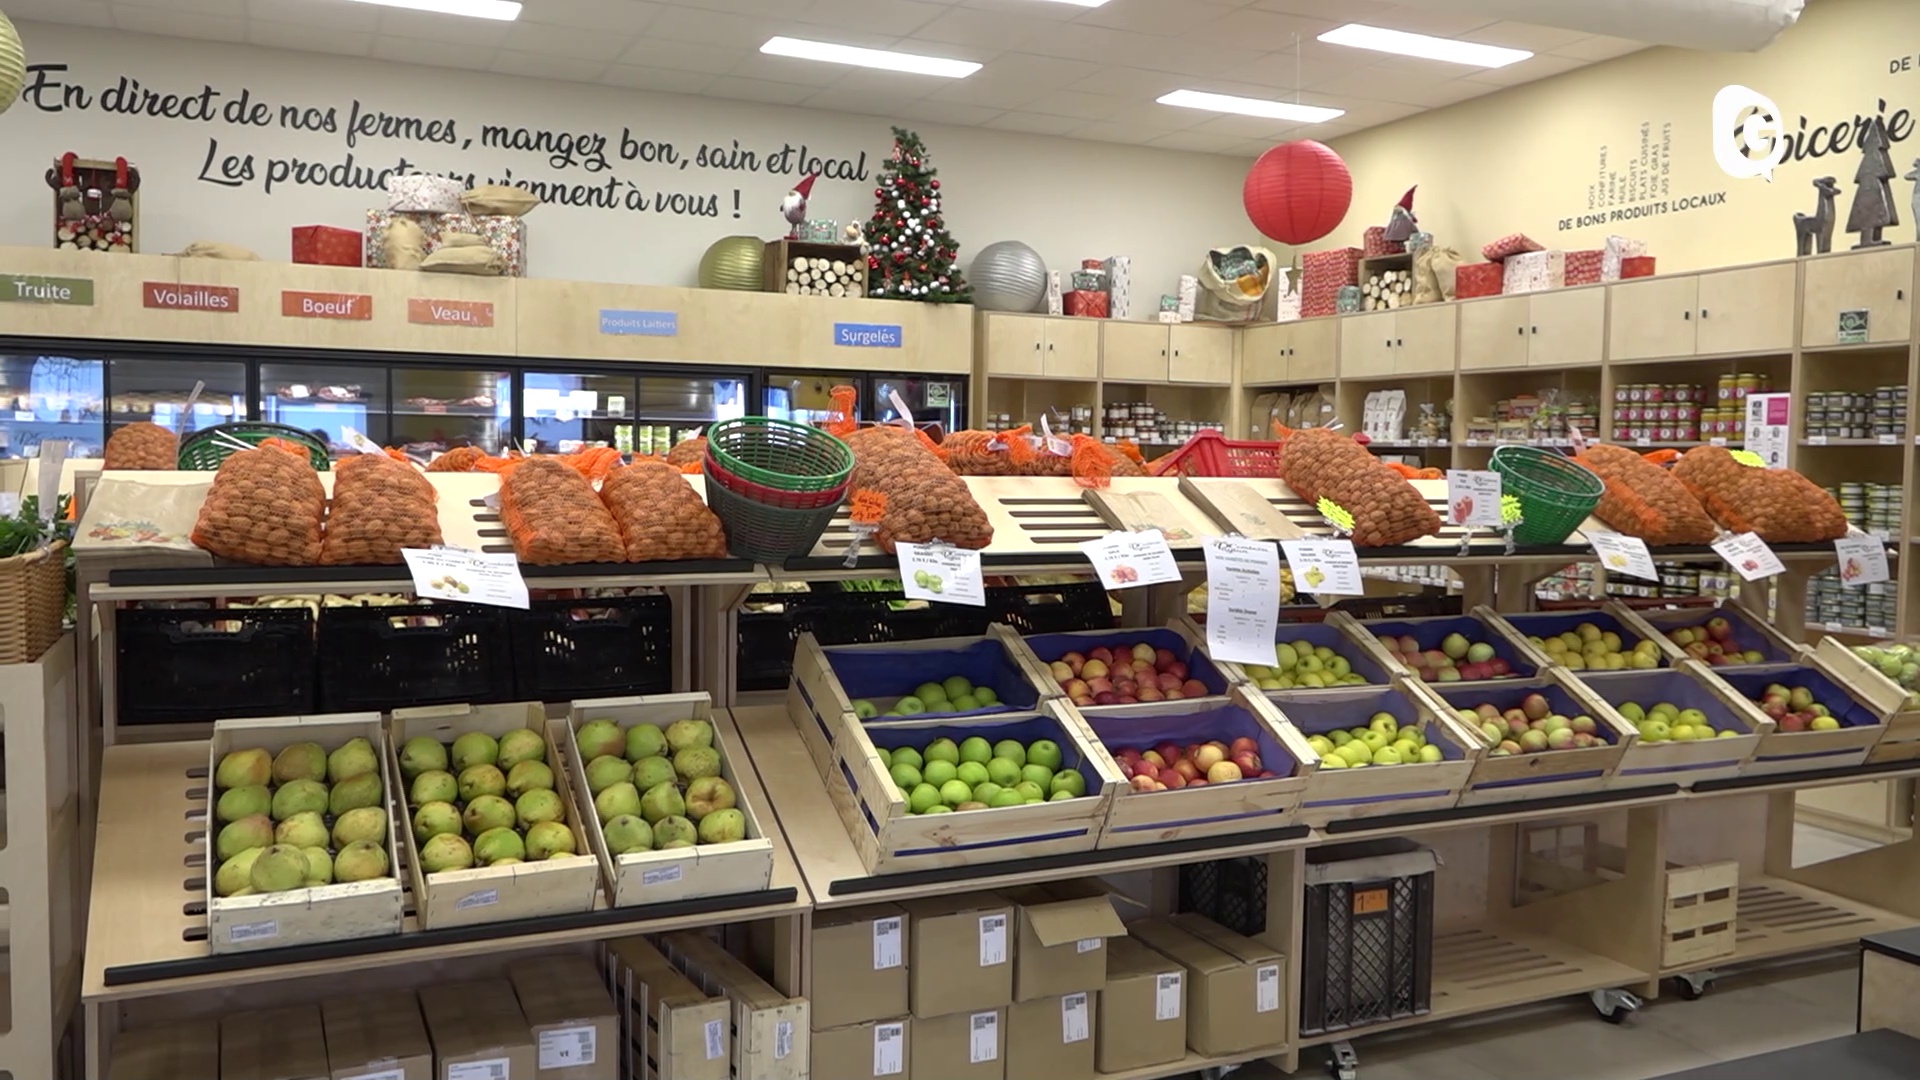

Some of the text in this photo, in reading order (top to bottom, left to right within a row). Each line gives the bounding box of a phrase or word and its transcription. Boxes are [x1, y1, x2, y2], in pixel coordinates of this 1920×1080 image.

[1889, 56, 1912, 74] DE
[23, 64, 92, 112] En
[100, 75, 221, 121] direct
[223, 88, 273, 126] de
[280, 104, 338, 134] nos
[482, 124, 612, 172] mangez
[620, 127, 690, 170] bon,
[696, 139, 761, 172] sain
[767, 143, 797, 175] et
[798, 145, 869, 181] local
[1650, 143, 1660, 199] FOIE GRAS
[1661, 122, 1672, 196] JUS DE FRUITS
[198, 137, 255, 187] Les
[625, 181, 650, 212] à
[655, 191, 719, 218] vous
[732, 189, 742, 219] !
[1598, 145, 1607, 207] CONFITURES
[1608, 171, 1617, 206] FARINE
[1619, 176, 1627, 204] HUILE
[1629, 159, 1638, 202] BISCUITS
[1639, 169, 1648, 201] PLATS
[1558, 191, 1727, 231] DE BONS PRODUITS LOCAUX
[1588, 185, 1596, 210] NOIX
[14, 281, 71, 300] Truite
[152, 288, 229, 308] Volailles
[303, 298, 353, 315] Boeuf
[431, 305, 471, 321] Veau
[602, 317, 641, 329] Produits
[842, 328, 896, 346] Surgelés
